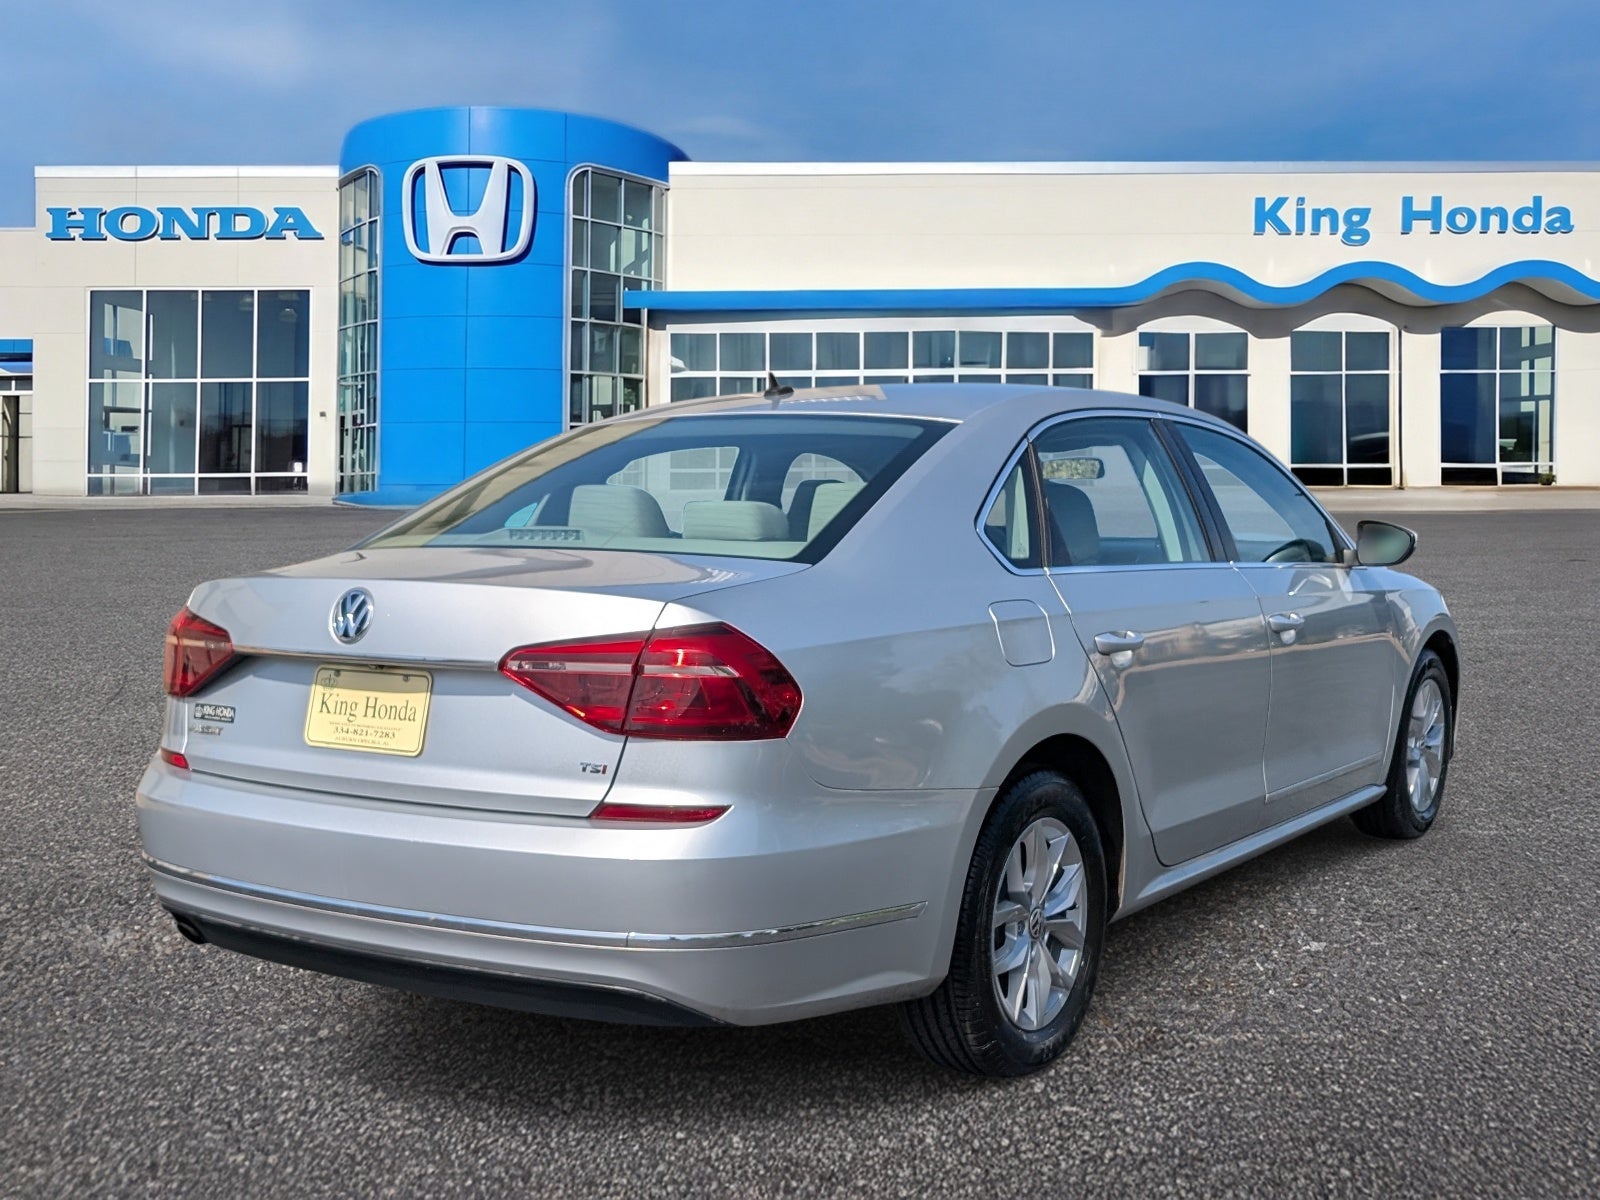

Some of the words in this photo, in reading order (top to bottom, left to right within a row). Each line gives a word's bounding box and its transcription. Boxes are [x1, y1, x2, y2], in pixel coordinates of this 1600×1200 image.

[45, 206, 325, 241] HONDA
[1253, 196, 1371, 246] King
[1401, 196, 1575, 236] Honda
[319, 692, 359, 723] King
[363, 696, 417, 722] Honda
[332, 726, 396, 740] 334-821-7283
[580, 762, 608, 774] TSI
